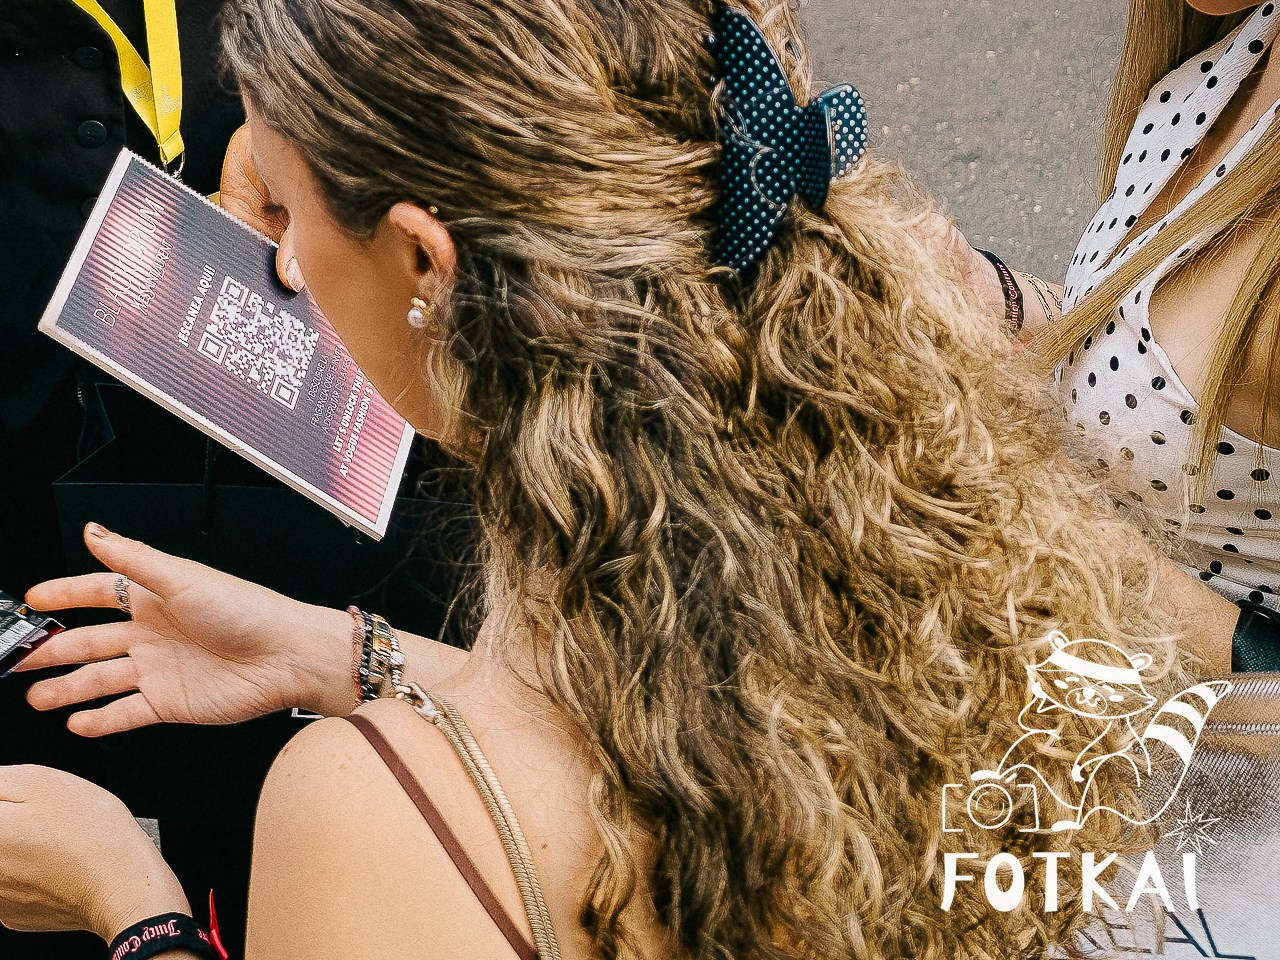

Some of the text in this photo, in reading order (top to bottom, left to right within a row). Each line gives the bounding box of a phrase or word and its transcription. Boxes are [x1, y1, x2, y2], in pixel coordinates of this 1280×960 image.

[92, 255, 139, 327] BLACK
[176, 293, 204, 347] ¡ESCANEA
[307, 361, 326, 397] DESCUBRE
[319, 352, 328, 364] LA
[322, 372, 334, 390] QUE
[327, 363, 337, 375] TE
[310, 386, 329, 427] FRAGANCIA
[323, 389, 340, 426] DISFRUTAR
[334, 379, 344, 391] DE
[340, 391, 358, 428] UNLOCK
[351, 373, 364, 393] THE
[342, 431, 359, 464] VOGUE
[339, 461, 349, 478] AT
[141, 919, 181, 941] Juicy
